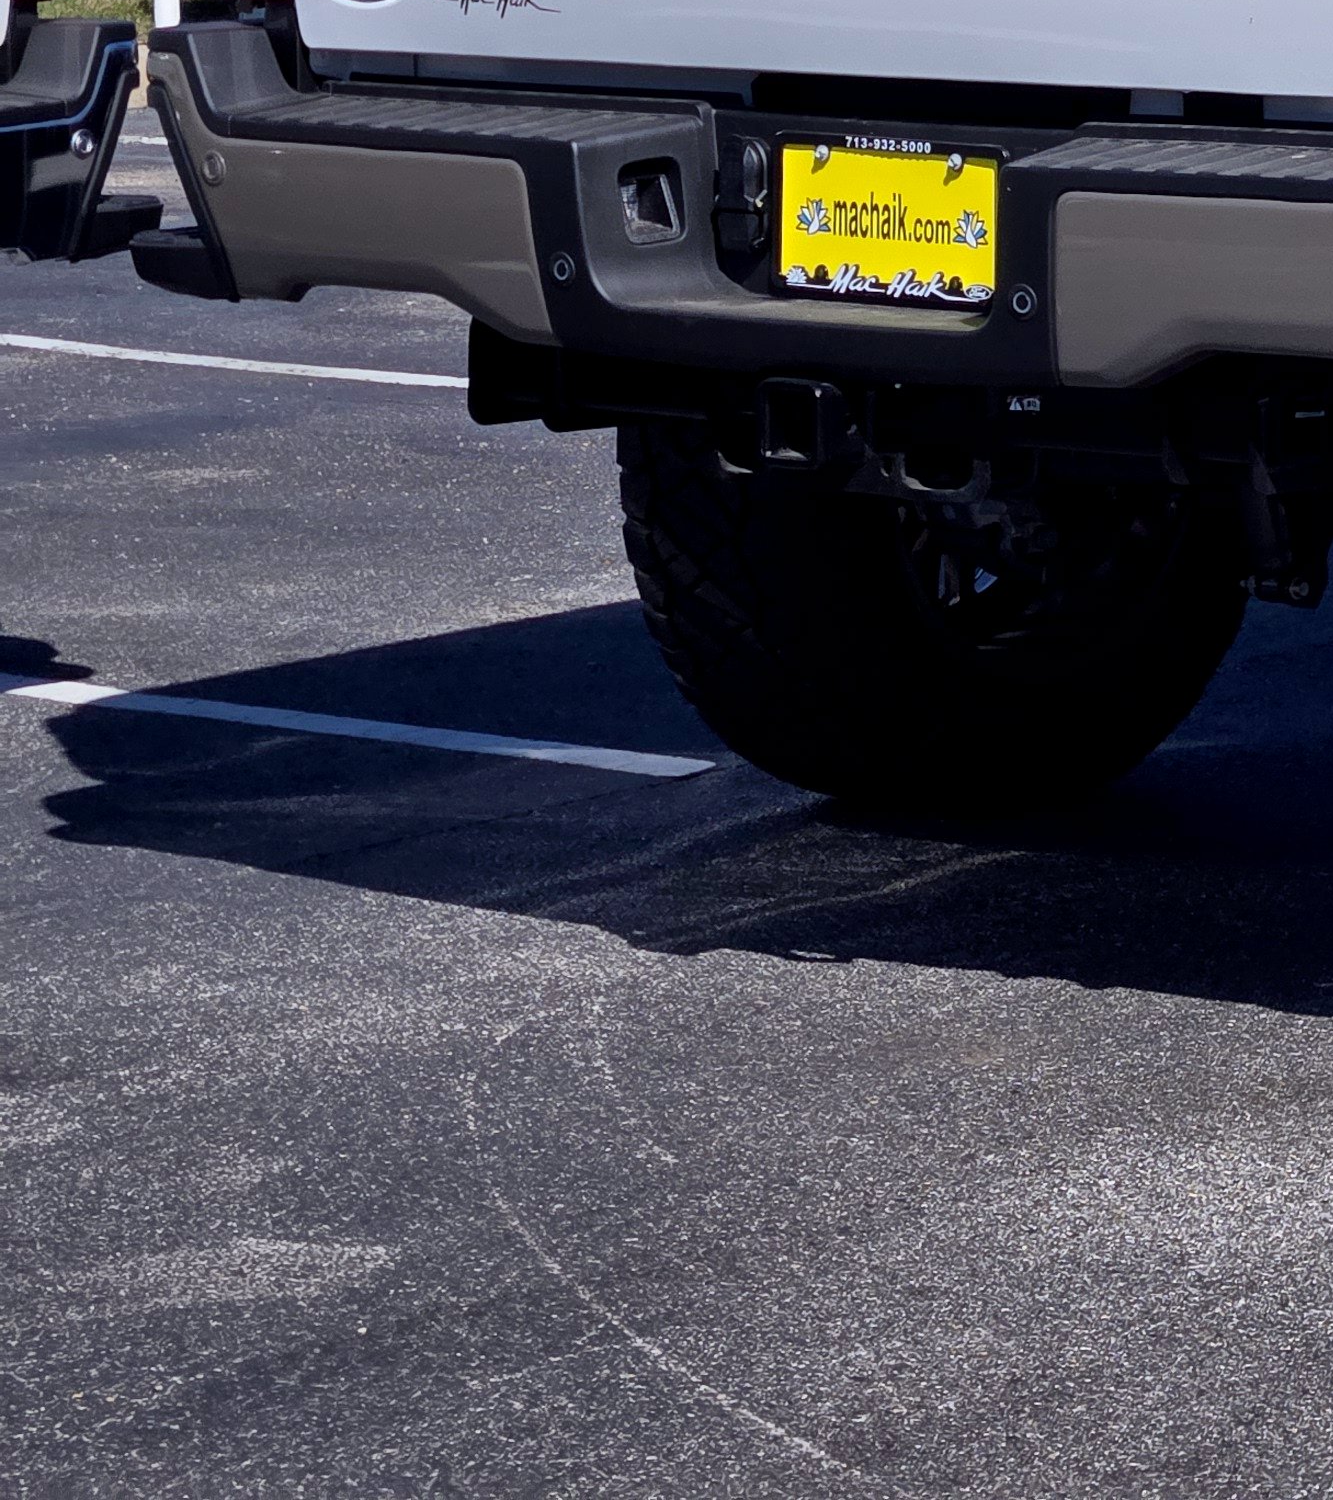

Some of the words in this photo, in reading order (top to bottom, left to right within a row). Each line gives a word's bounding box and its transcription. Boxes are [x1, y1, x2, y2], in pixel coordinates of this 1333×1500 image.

[833, 191, 951, 245] machaik.com
[830, 264, 880, 294] Mac
[886, 270, 945, 298] Haik
